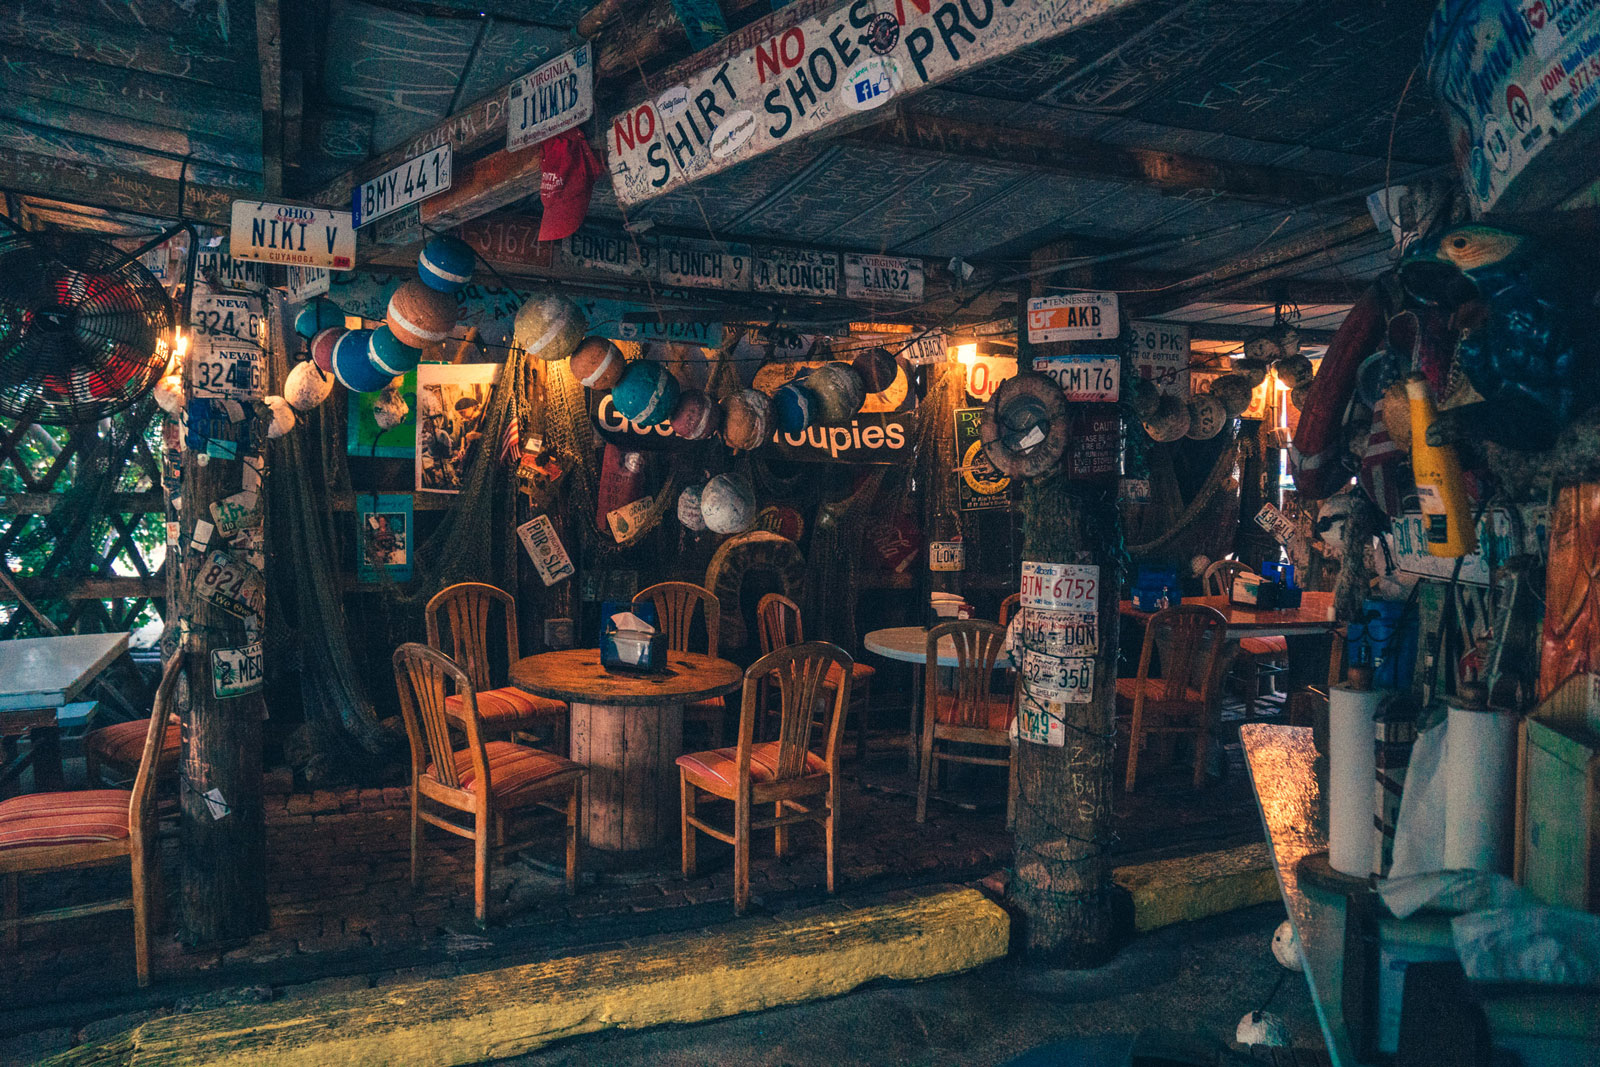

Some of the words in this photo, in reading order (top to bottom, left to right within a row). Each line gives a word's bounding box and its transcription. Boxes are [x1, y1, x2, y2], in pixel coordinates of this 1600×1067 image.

[755, 26, 806, 84] NO
[904, 0, 1013, 83] PRO
[529, 59, 571, 89] VIRGINIA
[763, 0, 876, 139] SHOES
[1540, 63, 1567, 96] JOIN
[613, 104, 656, 157] NO
[646, 61, 738, 189] SHIRT
[365, 170, 399, 218] BMY
[402, 151, 441, 200] 441
[277, 206, 315, 221] OHIO
[251, 217, 309, 252] NIKI
[325, 225, 339, 256] V
[570, 233, 628, 265] CONCH
[269, 252, 315, 264] CUYAHOGA
[669, 249, 723, 279] CONCH
[732, 255, 744, 281] 9
[863, 257, 906, 271] VIRGINIA
[759, 260, 771, 286] A
[777, 263, 837, 291] CONCH
[862, 266, 910, 291] EAN32
[1048, 296, 1098, 306] TENNESSEE
[1067, 305, 1101, 328] AKB
[196, 310, 240, 336] 324
[198, 361, 238, 388] 324
